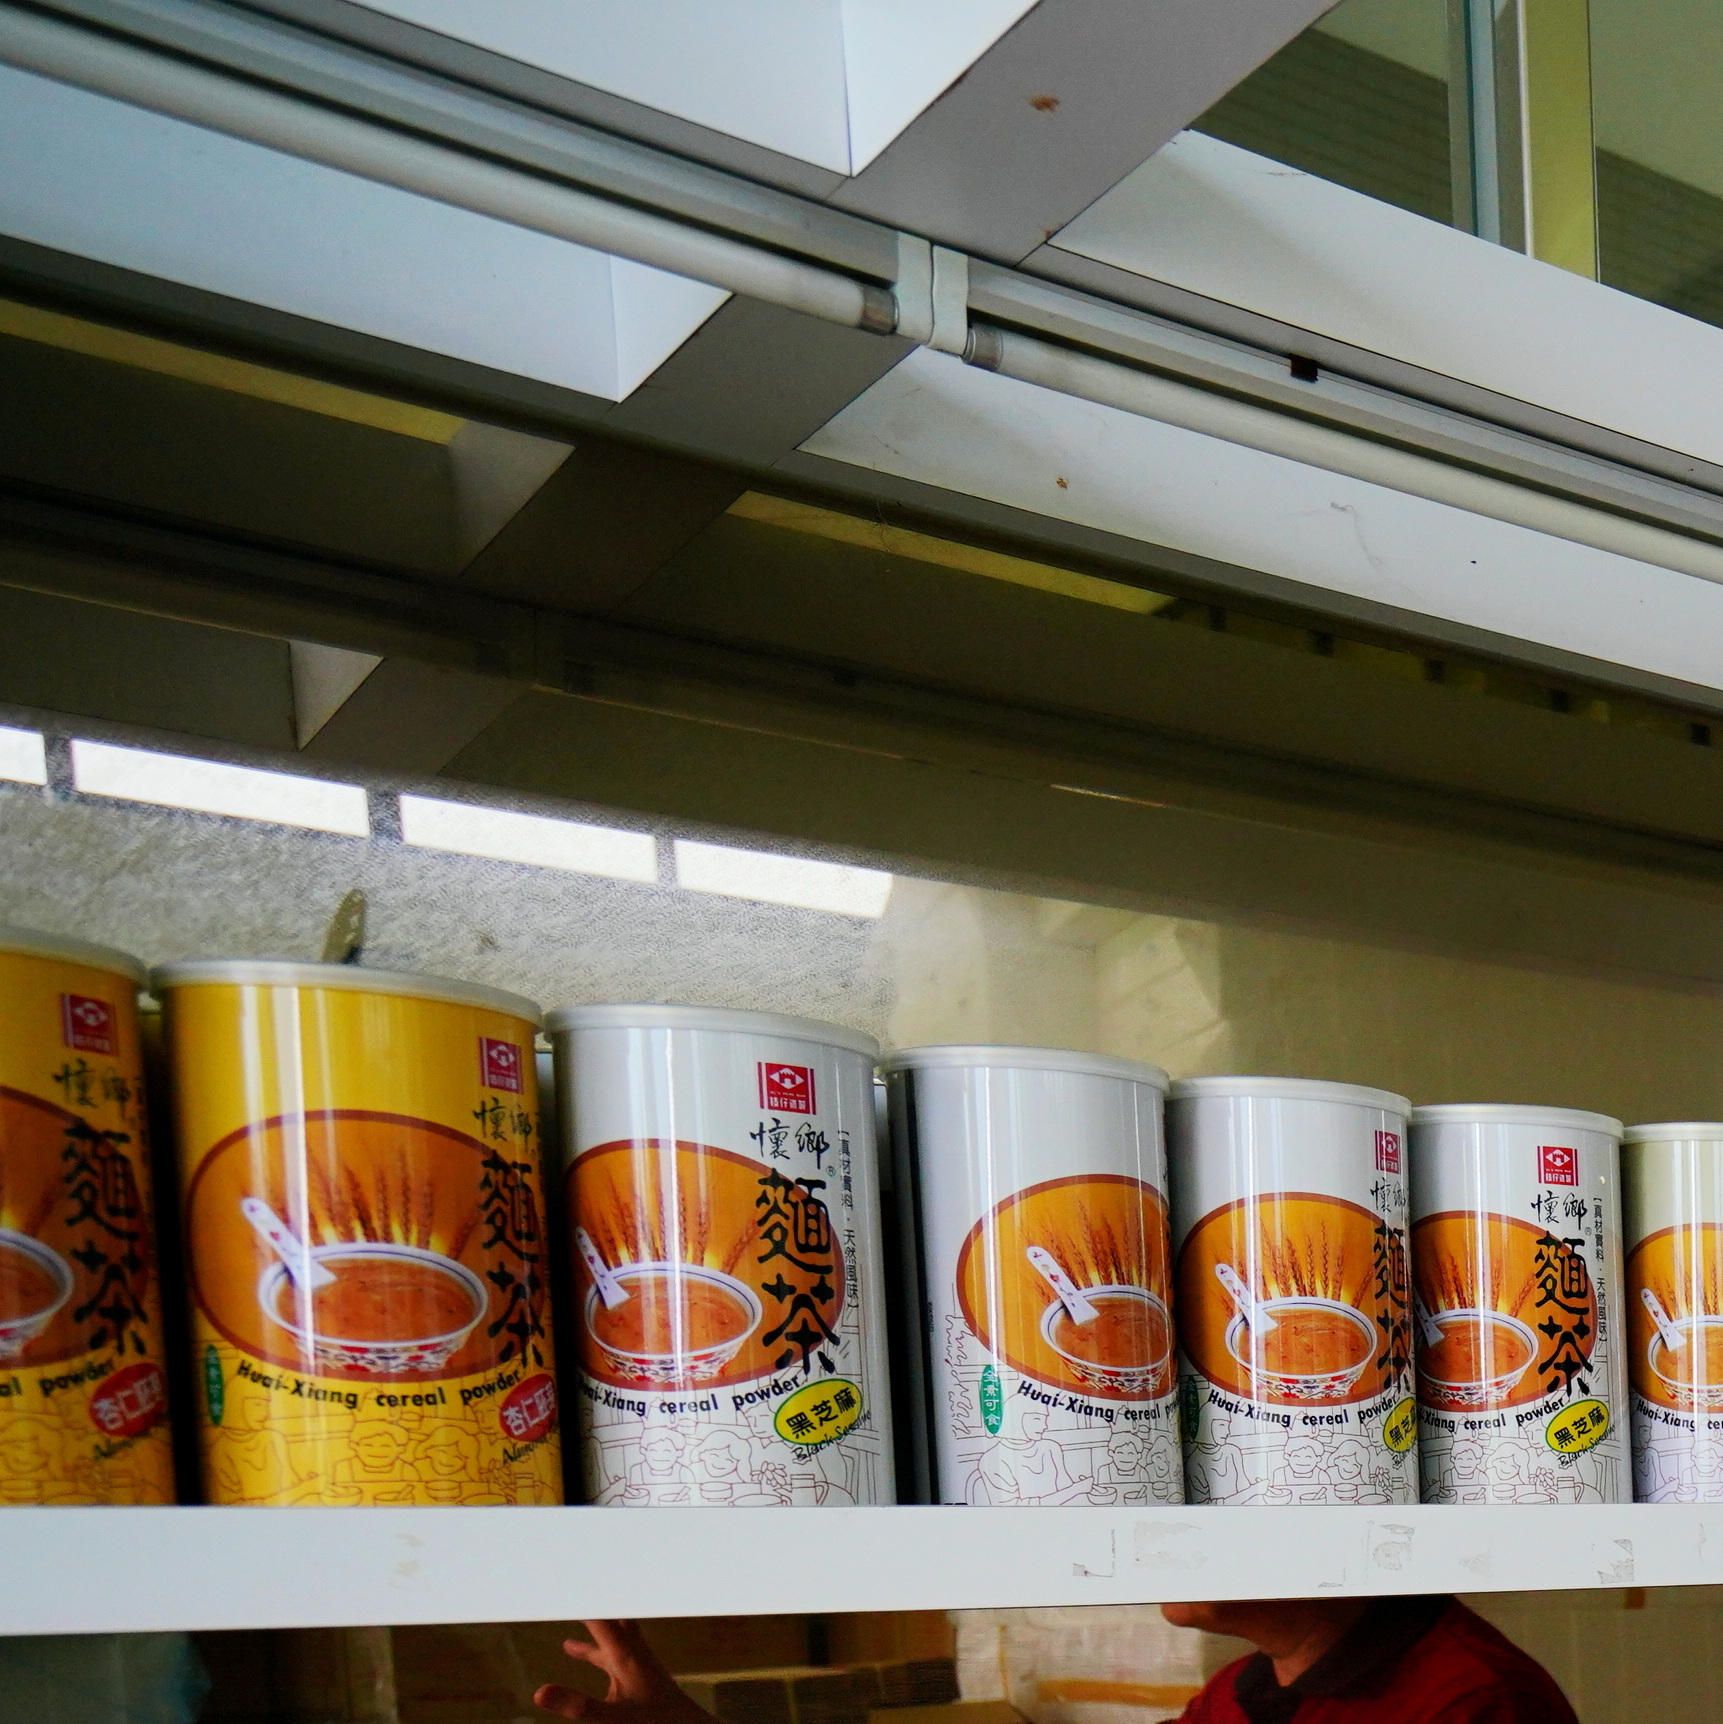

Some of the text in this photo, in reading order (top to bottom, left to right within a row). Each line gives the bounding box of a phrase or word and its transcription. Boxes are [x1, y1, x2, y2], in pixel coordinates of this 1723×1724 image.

[755, 1168, 840, 1375] 麵茶
[1535, 1231, 1593, 1396] 麵茶
[237, 1360, 358, 1408] Huai-Xiang
[376, 1387, 445, 1407] cereal
[461, 1369, 521, 1405] powder
[576, 1375, 800, 1416] uai-Xiang cereal powder
[1017, 1380, 1115, 1423] Huai-Xiang
[1124, 1405, 1160, 1421] cereal
[785, 1387, 858, 1438] 黑芝麻
[1208, 1389, 1291, 1428] Huai-Xiang
[1302, 1410, 1348, 1427] cereal
[1357, 1392, 1399, 1424] powder
[1464, 1398, 1563, 1429] cereal powder
[1555, 1407, 1605, 1448] 黑芝麻
[1637, 1398, 1696, 1430] Huai-Xiang
